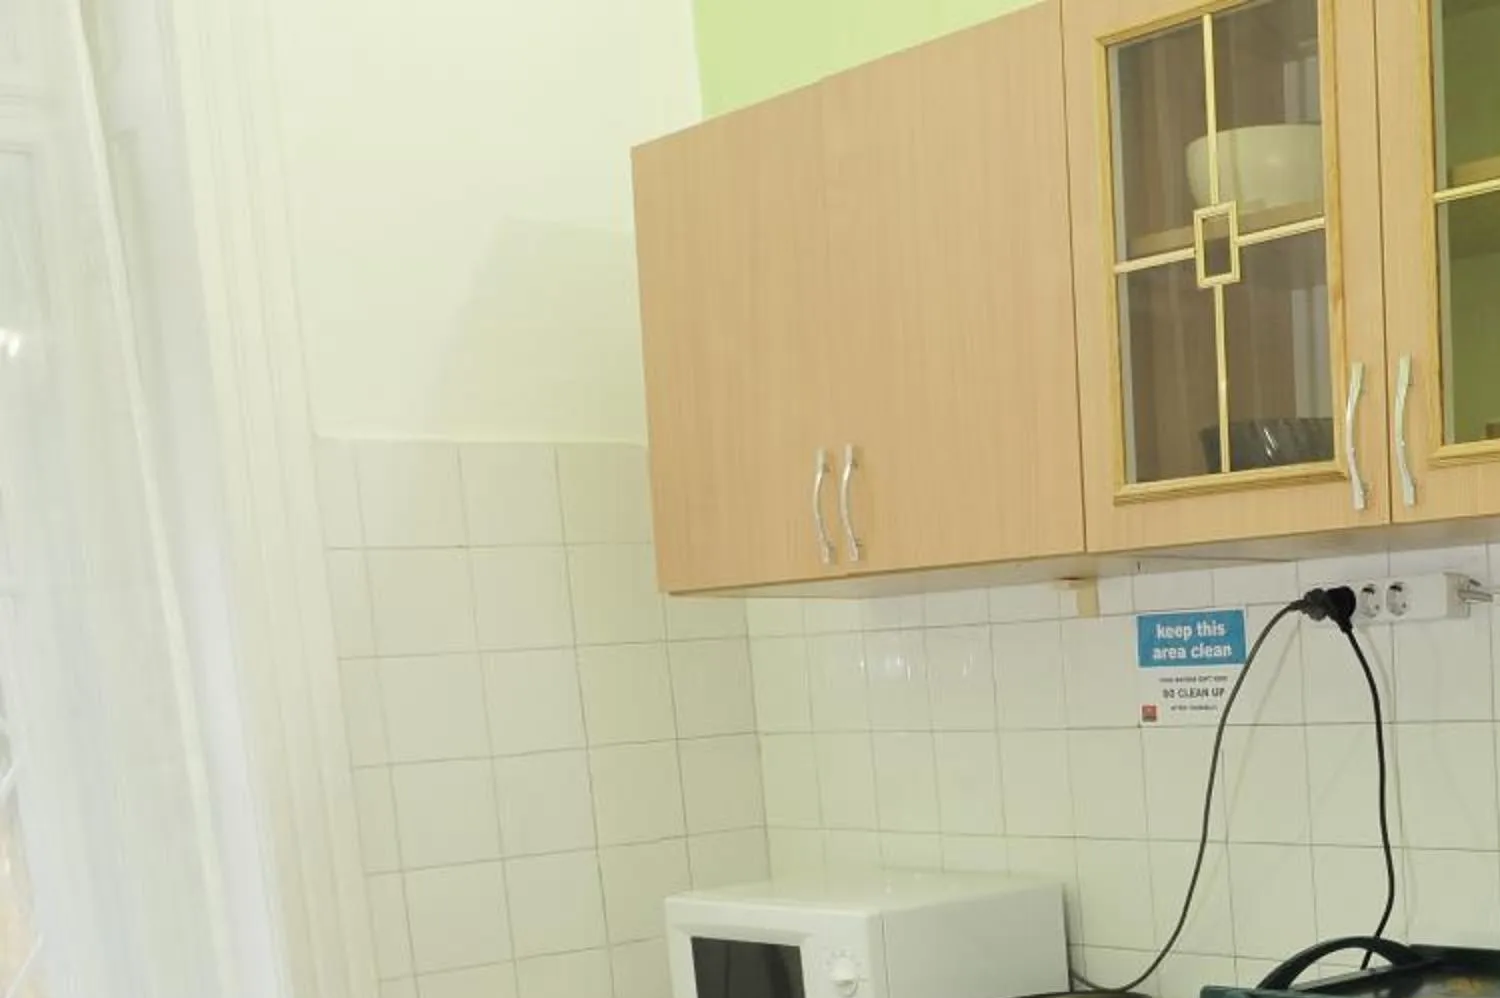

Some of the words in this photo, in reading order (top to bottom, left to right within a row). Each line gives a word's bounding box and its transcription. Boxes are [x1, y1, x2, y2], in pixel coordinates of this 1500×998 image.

[1156, 624, 1192, 640] keep
[1196, 620, 1226, 637] this
[1152, 647, 1187, 660] area
[1191, 642, 1232, 658] clean
